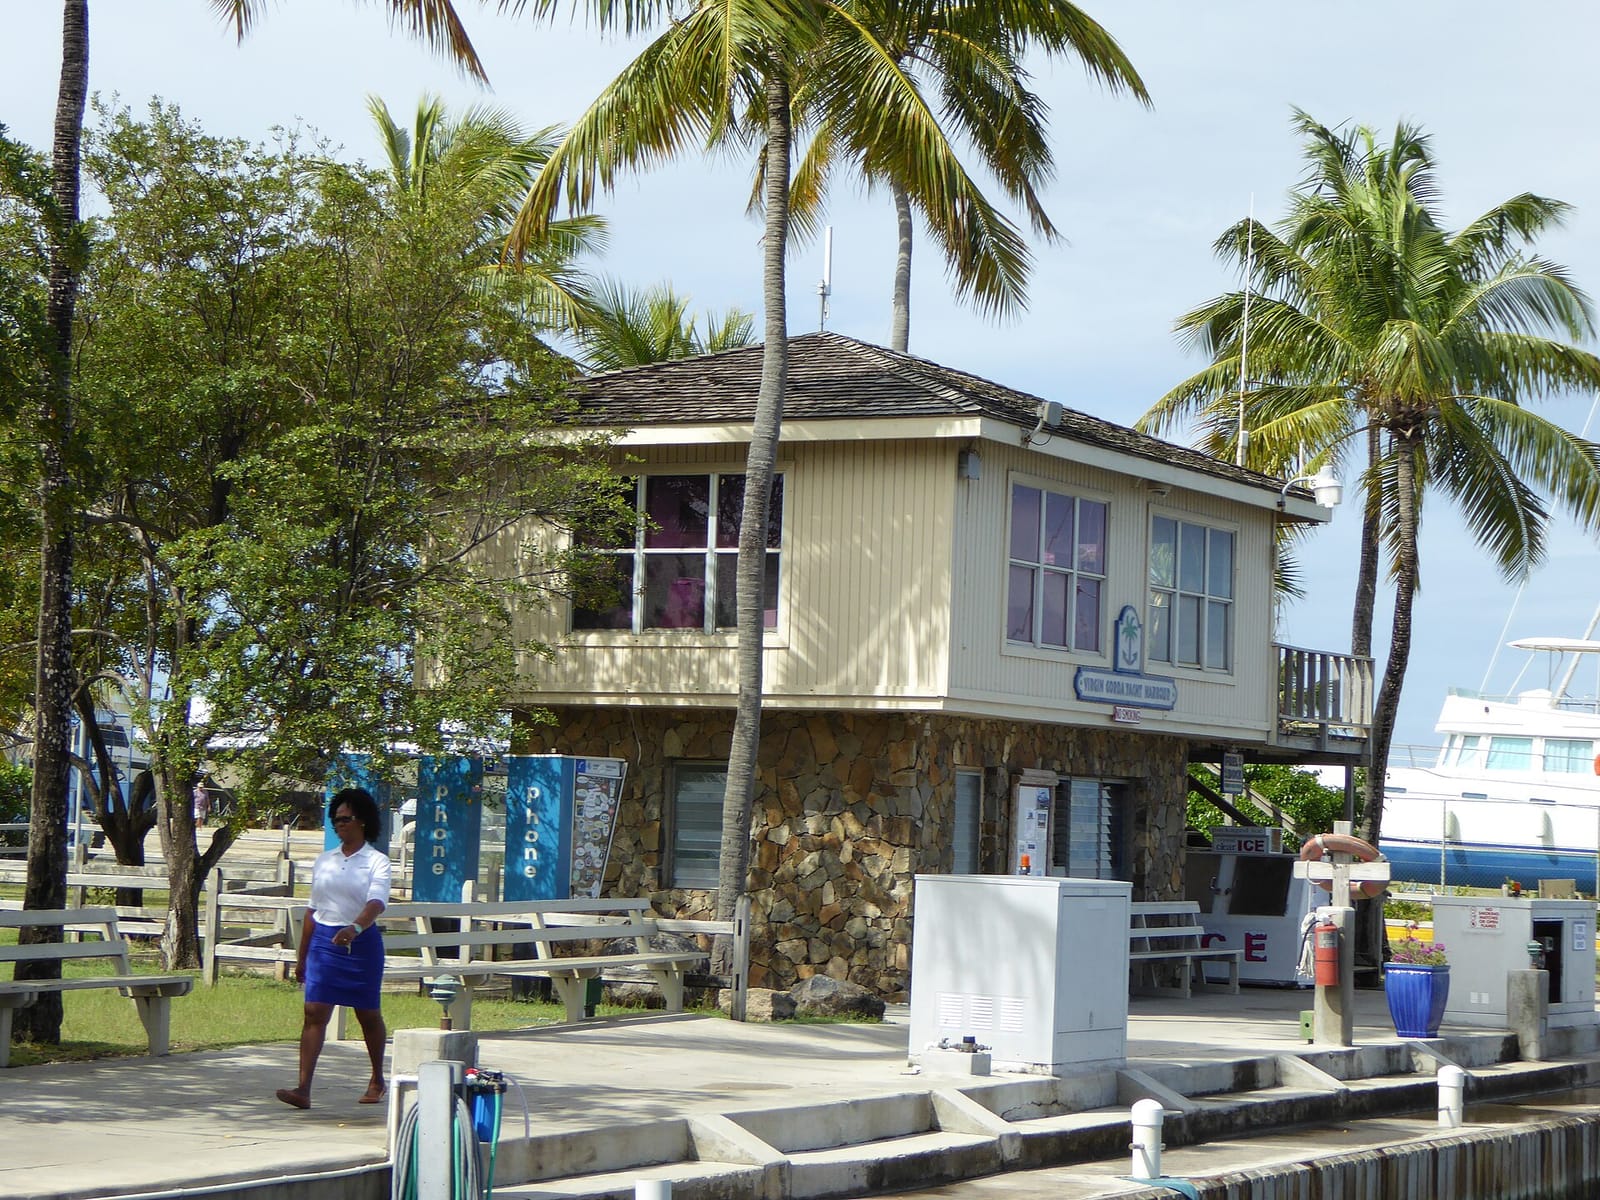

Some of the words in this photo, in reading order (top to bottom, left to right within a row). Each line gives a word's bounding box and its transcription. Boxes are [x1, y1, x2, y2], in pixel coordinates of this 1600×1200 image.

[432, 784, 448, 876] phone
[524, 786, 540, 879] phone
[1237, 839, 1265, 852] ICE
